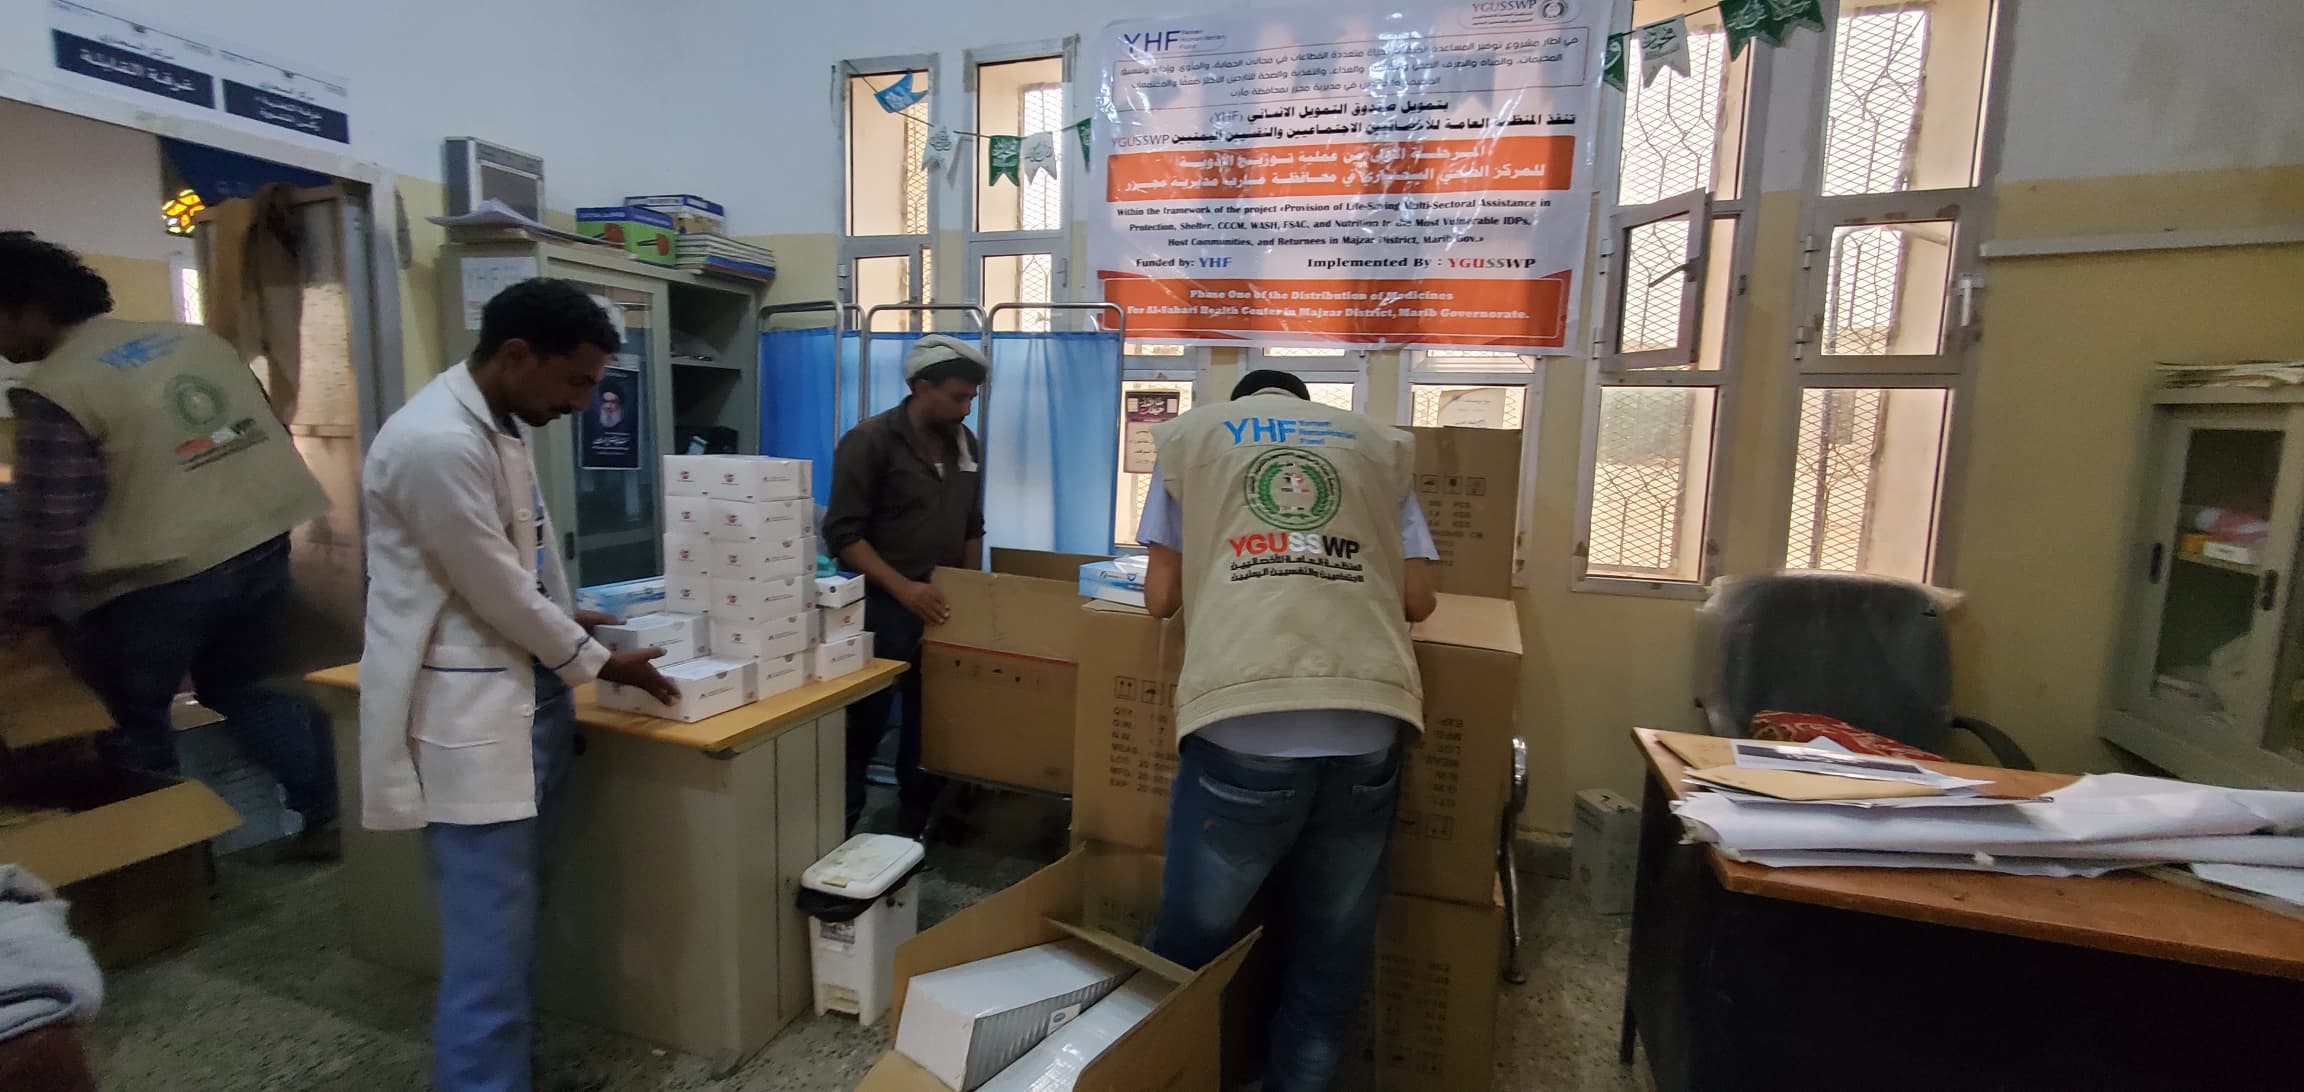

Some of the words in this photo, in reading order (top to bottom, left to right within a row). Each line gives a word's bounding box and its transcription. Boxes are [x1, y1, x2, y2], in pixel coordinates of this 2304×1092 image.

[1124, 31, 1180, 53] YHF
[1299, 103, 1348, 120] التمويل
[1163, 206, 1210, 215] framework
[1214, 205, 1225, 214] of
[1226, 205, 1241, 214] the
[1244, 205, 1277, 216] project
[1333, 202, 1344, 212] of
[1480, 198, 1536, 208] Assistance
[1540, 198, 1551, 208] in
[1313, 219, 1332, 228] and
[1415, 218, 1439, 227] Most
[1257, 237, 1275, 246] and
[1278, 236, 1327, 246] Returnees
[1329, 236, 1339, 245] in
[1136, 258, 1175, 268] Funded
[1199, 257, 1232, 268] YHF
[1308, 257, 1408, 270] Implemented
[1413, 258, 1432, 270] By
[1448, 257, 1536, 269] YGUSSWP
[1223, 416, 1298, 446] YHF
[1228, 531, 1361, 559] YGUSSWP
